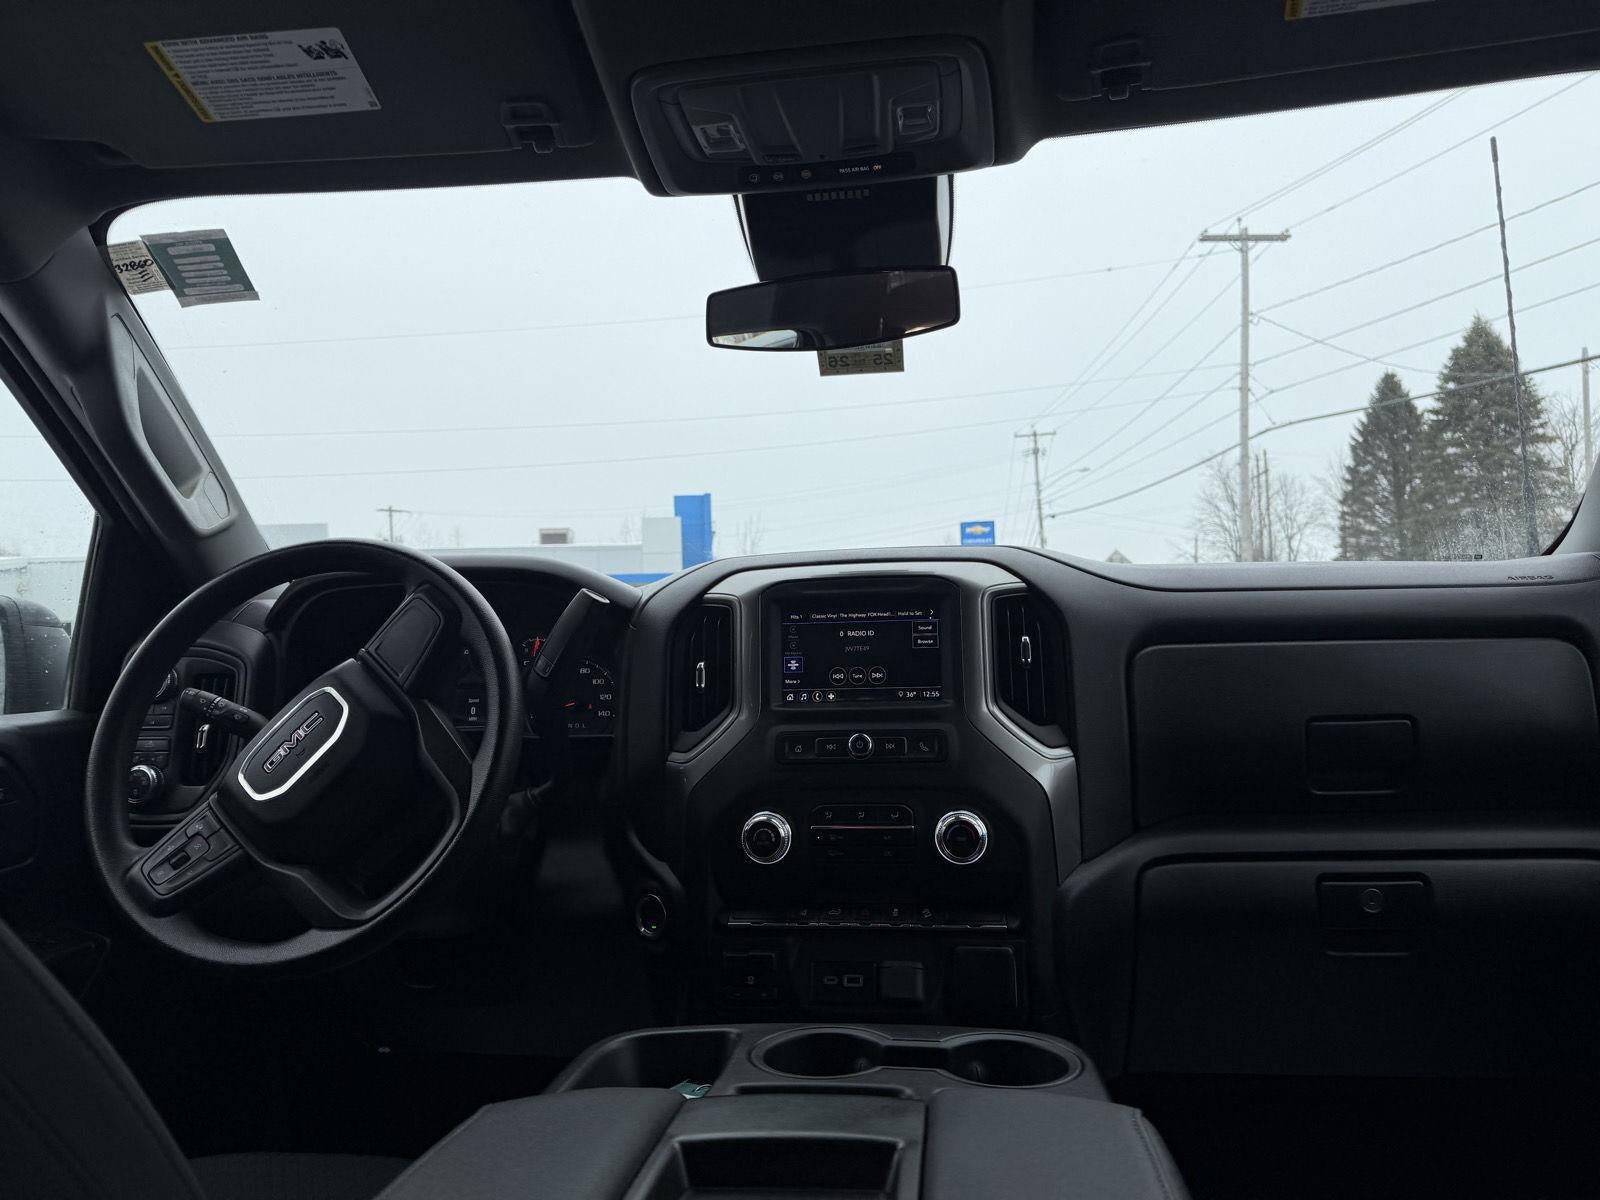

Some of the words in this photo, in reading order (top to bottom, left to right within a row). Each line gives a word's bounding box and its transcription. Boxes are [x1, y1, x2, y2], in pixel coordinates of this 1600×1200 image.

[847, 629, 867, 637] RADIO
[923, 690, 940, 698] 12:55
[263, 711, 324, 774] GMC
